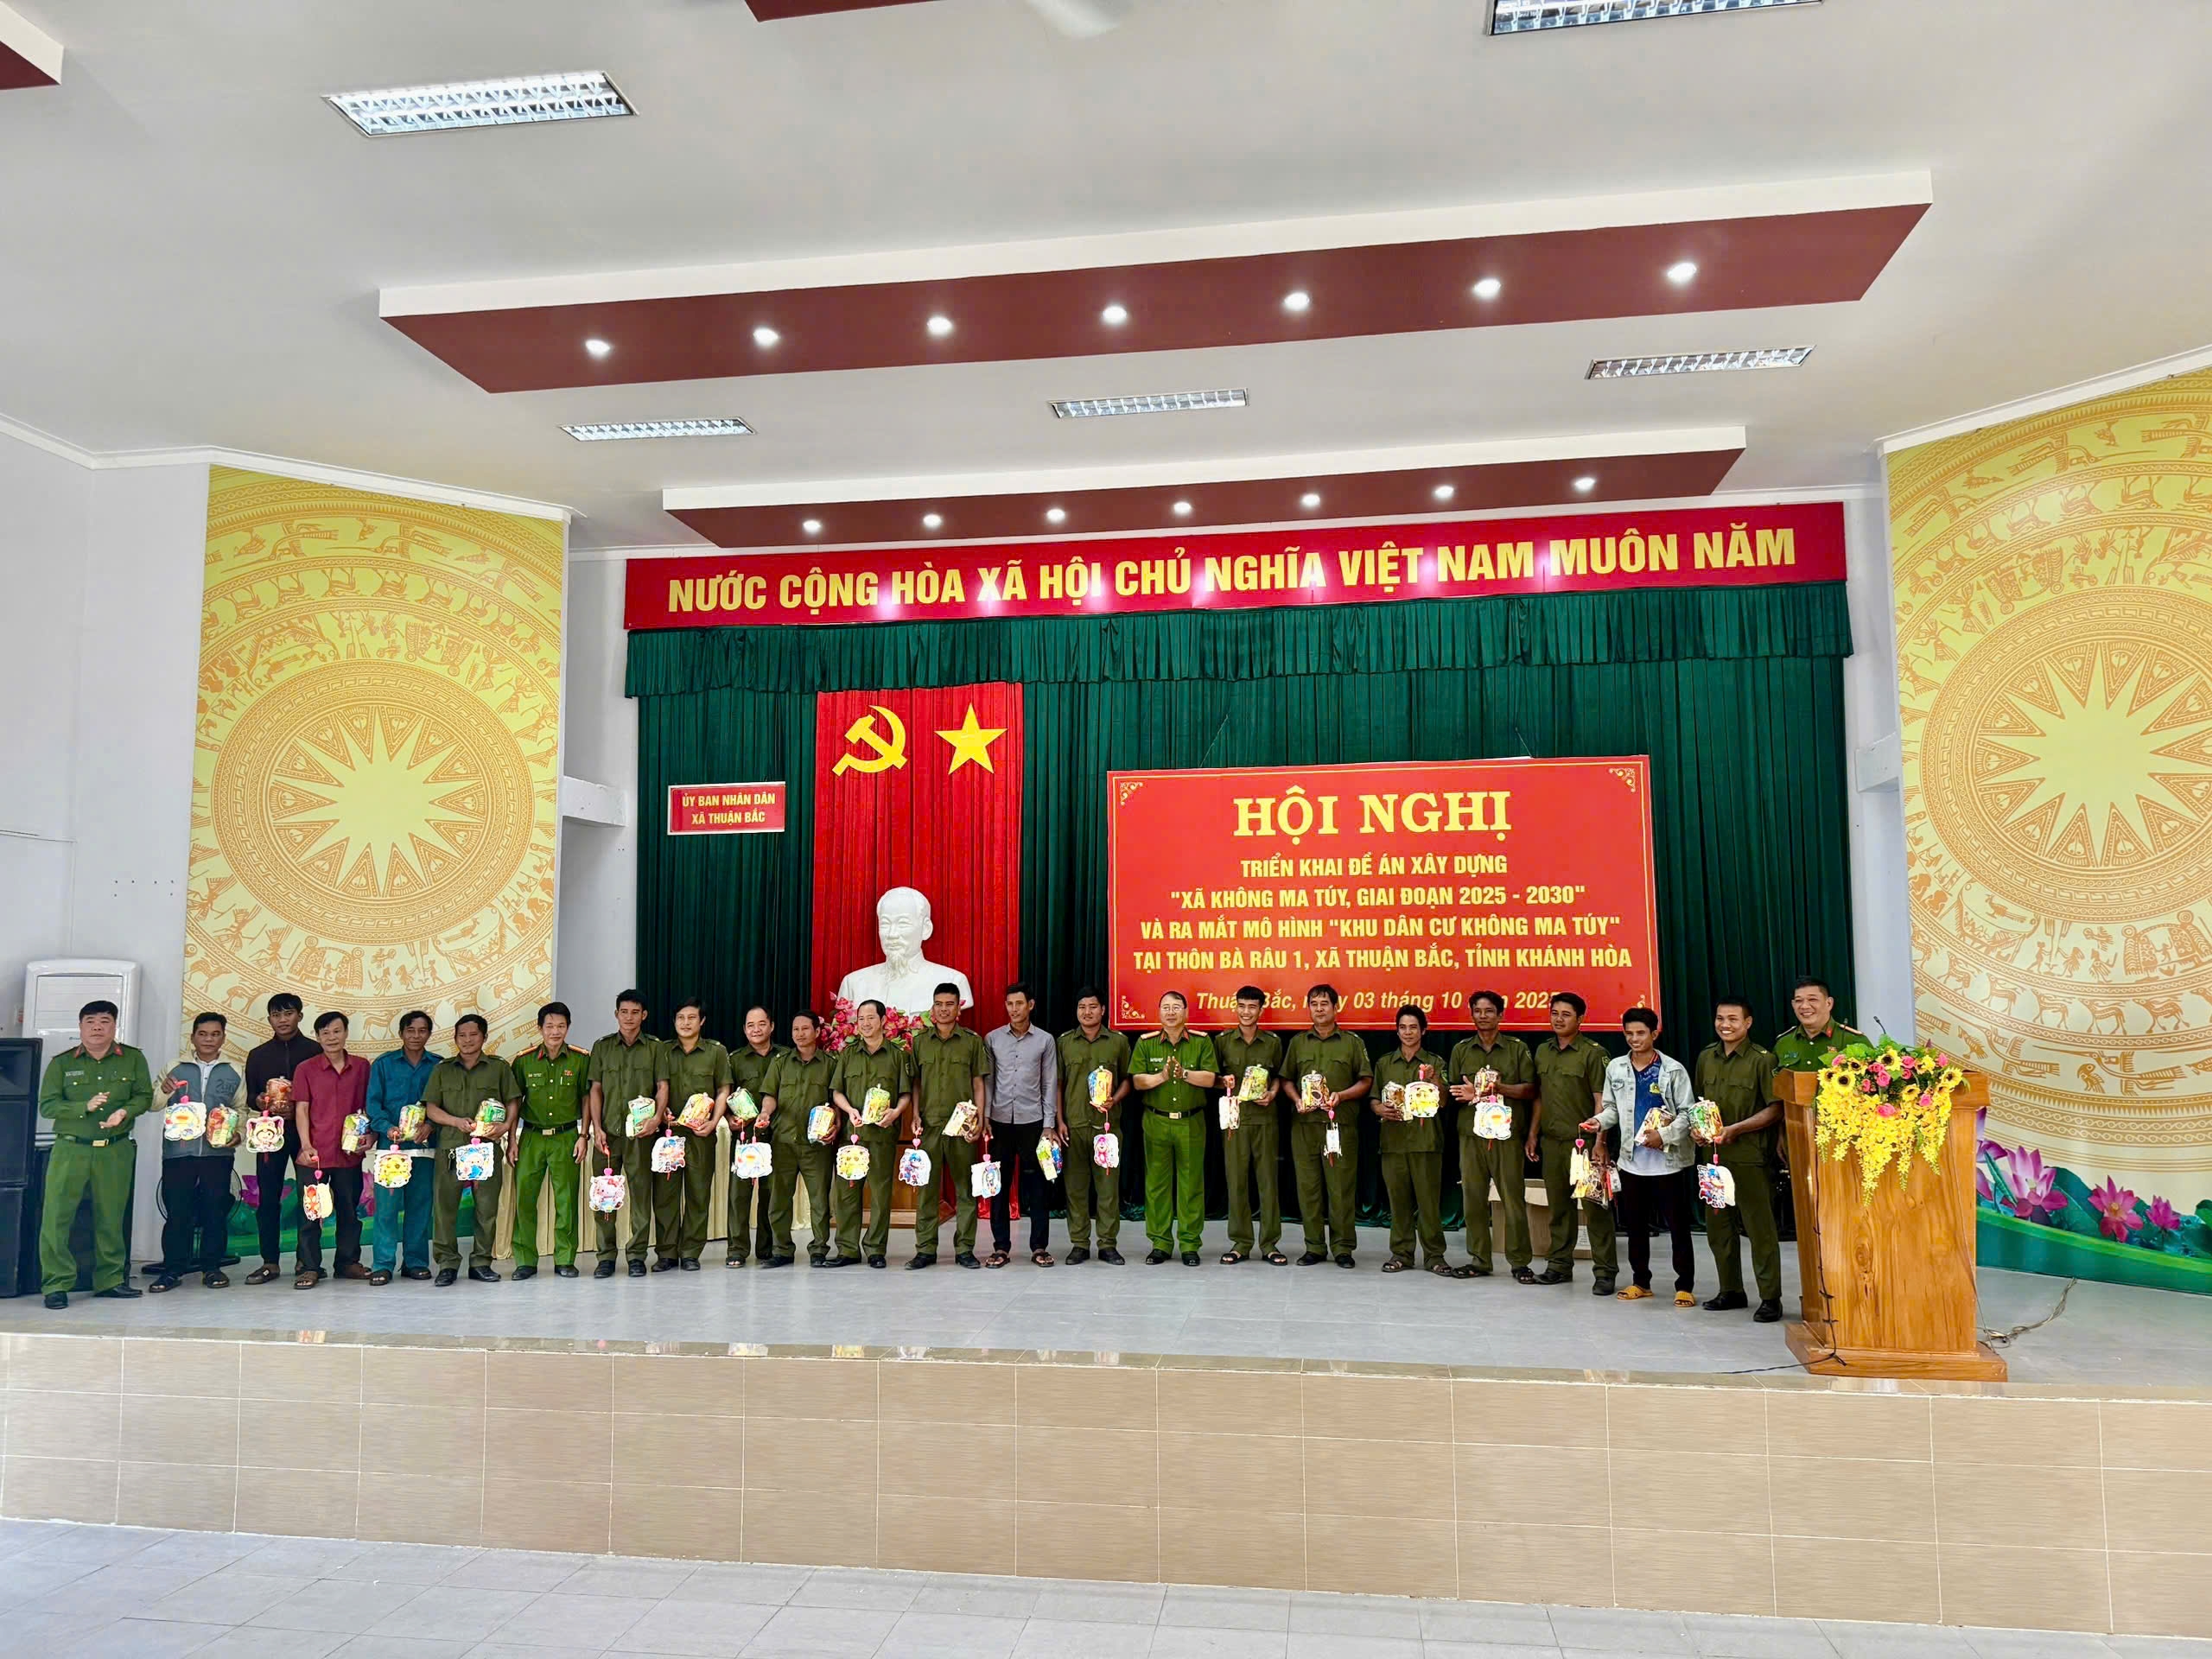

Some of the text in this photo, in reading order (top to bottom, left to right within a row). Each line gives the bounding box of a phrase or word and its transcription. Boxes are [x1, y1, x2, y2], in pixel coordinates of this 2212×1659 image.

[669, 522, 1796, 615] NƯỚC CỘNG HÒA XÃ HỘI CHỦ NGHĨA VIỆT NAM MUÔN NĂM
[682, 791, 776, 807] ỦY BAN NHÂN DÂN
[691, 807, 766, 826] XÃ THUẬN BẮC
[1233, 785, 1512, 846] HỘI NGHỊ
[1240, 851, 1508, 878] TRIỂN KHAI ĐỀ ÁN XÂY DỰNG
[1171, 887, 1206, 909] "XÃ
[1211, 886, 1274, 909] KHÔNG
[1279, 889, 1310, 908] MA
[1313, 884, 1351, 909] TÚY,
[1357, 887, 1395, 906] GIAI
[1400, 887, 1453, 910] ĐOẠN
[1459, 886, 1507, 906] 2025
[1526, 885, 1586, 905] 2030"
[1140, 912, 1620, 939] VÀ RA MẮT MÔ HÌNH "KHU DÂN CƯ KHÔNG MA TÚY"
[1133, 941, 1632, 974] TẠI THÔN BÀ RÂU 1, XÃ THUẬN BẮC, TỈNH KHÁNH HÒA
[1197, 991, 1238, 1013] Thuậ
[1353, 991, 1376, 1009] 03
[1381, 990, 1434, 1014] tháng
[1441, 991, 1462, 1008] 10
